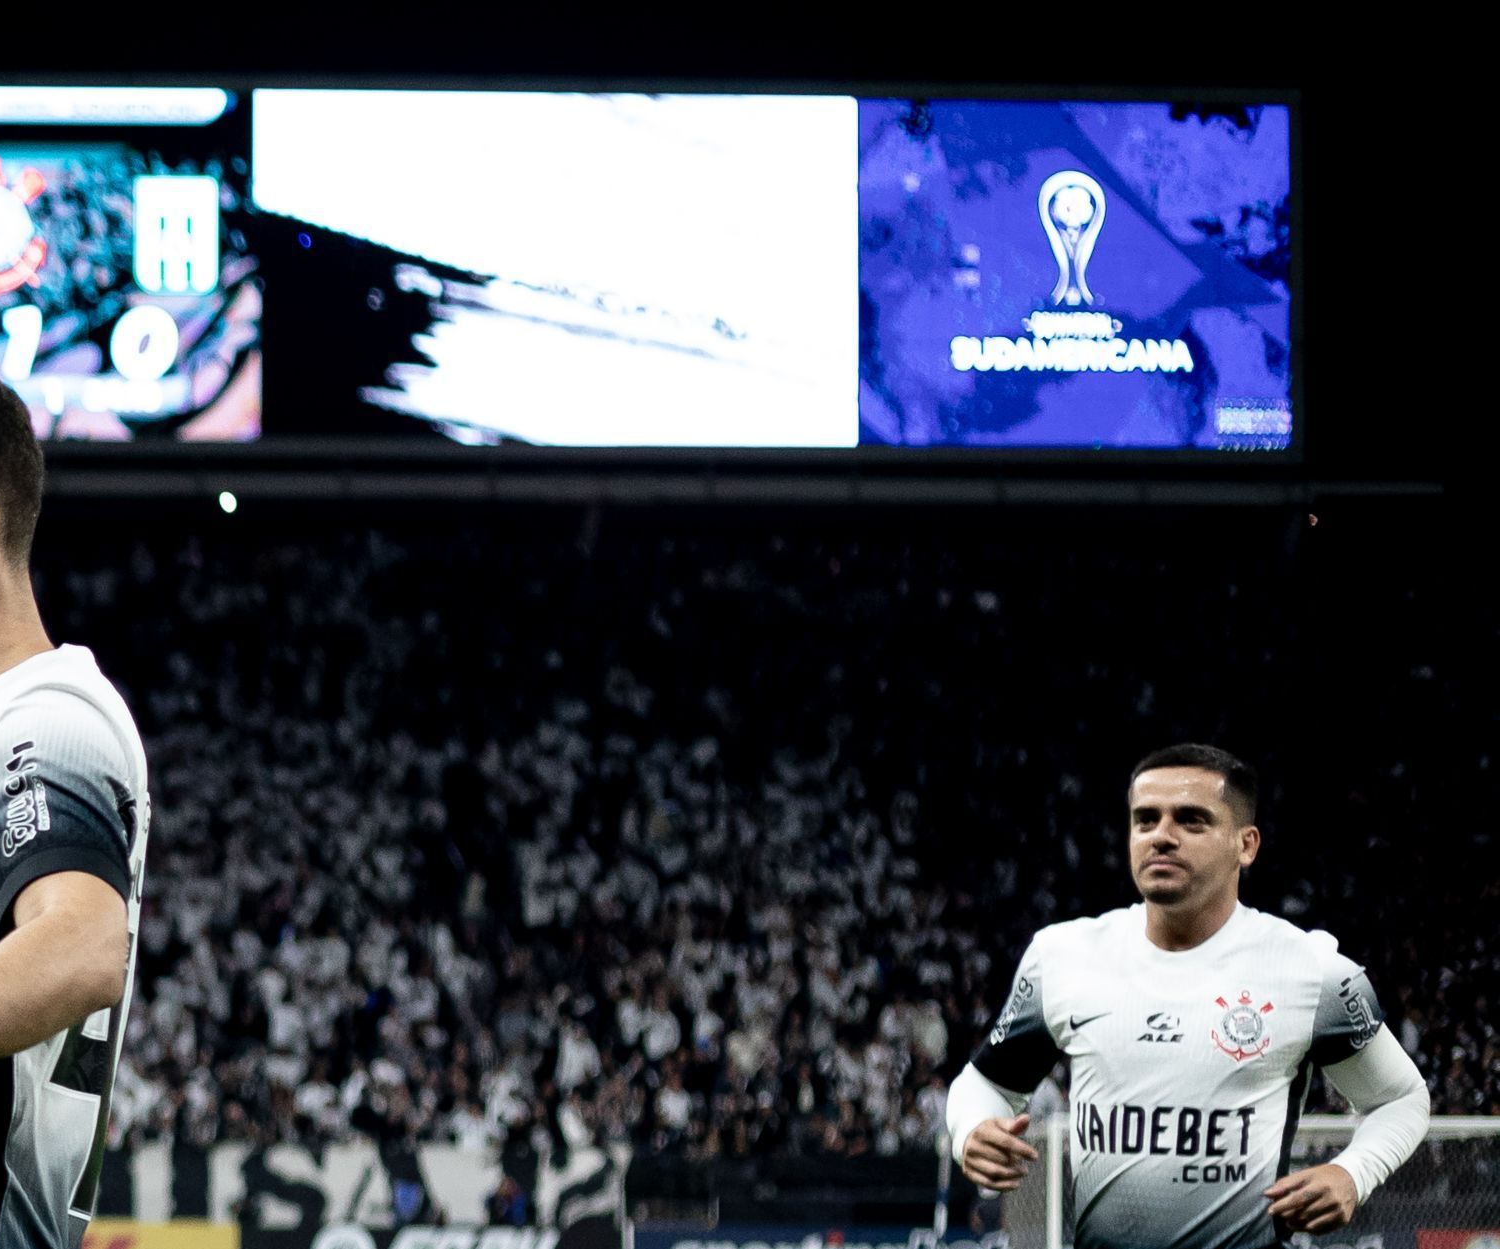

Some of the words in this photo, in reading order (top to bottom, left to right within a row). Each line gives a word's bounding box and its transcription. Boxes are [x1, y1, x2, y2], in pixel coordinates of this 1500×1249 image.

[111, 305, 179, 382] 0
[949, 337, 1194, 373] SUDAMERICANA
[1136, 1033, 1185, 1044] ALE
[1076, 1102, 1256, 1157] VAIDEBET
[1171, 1163, 1247, 1184] .COM
